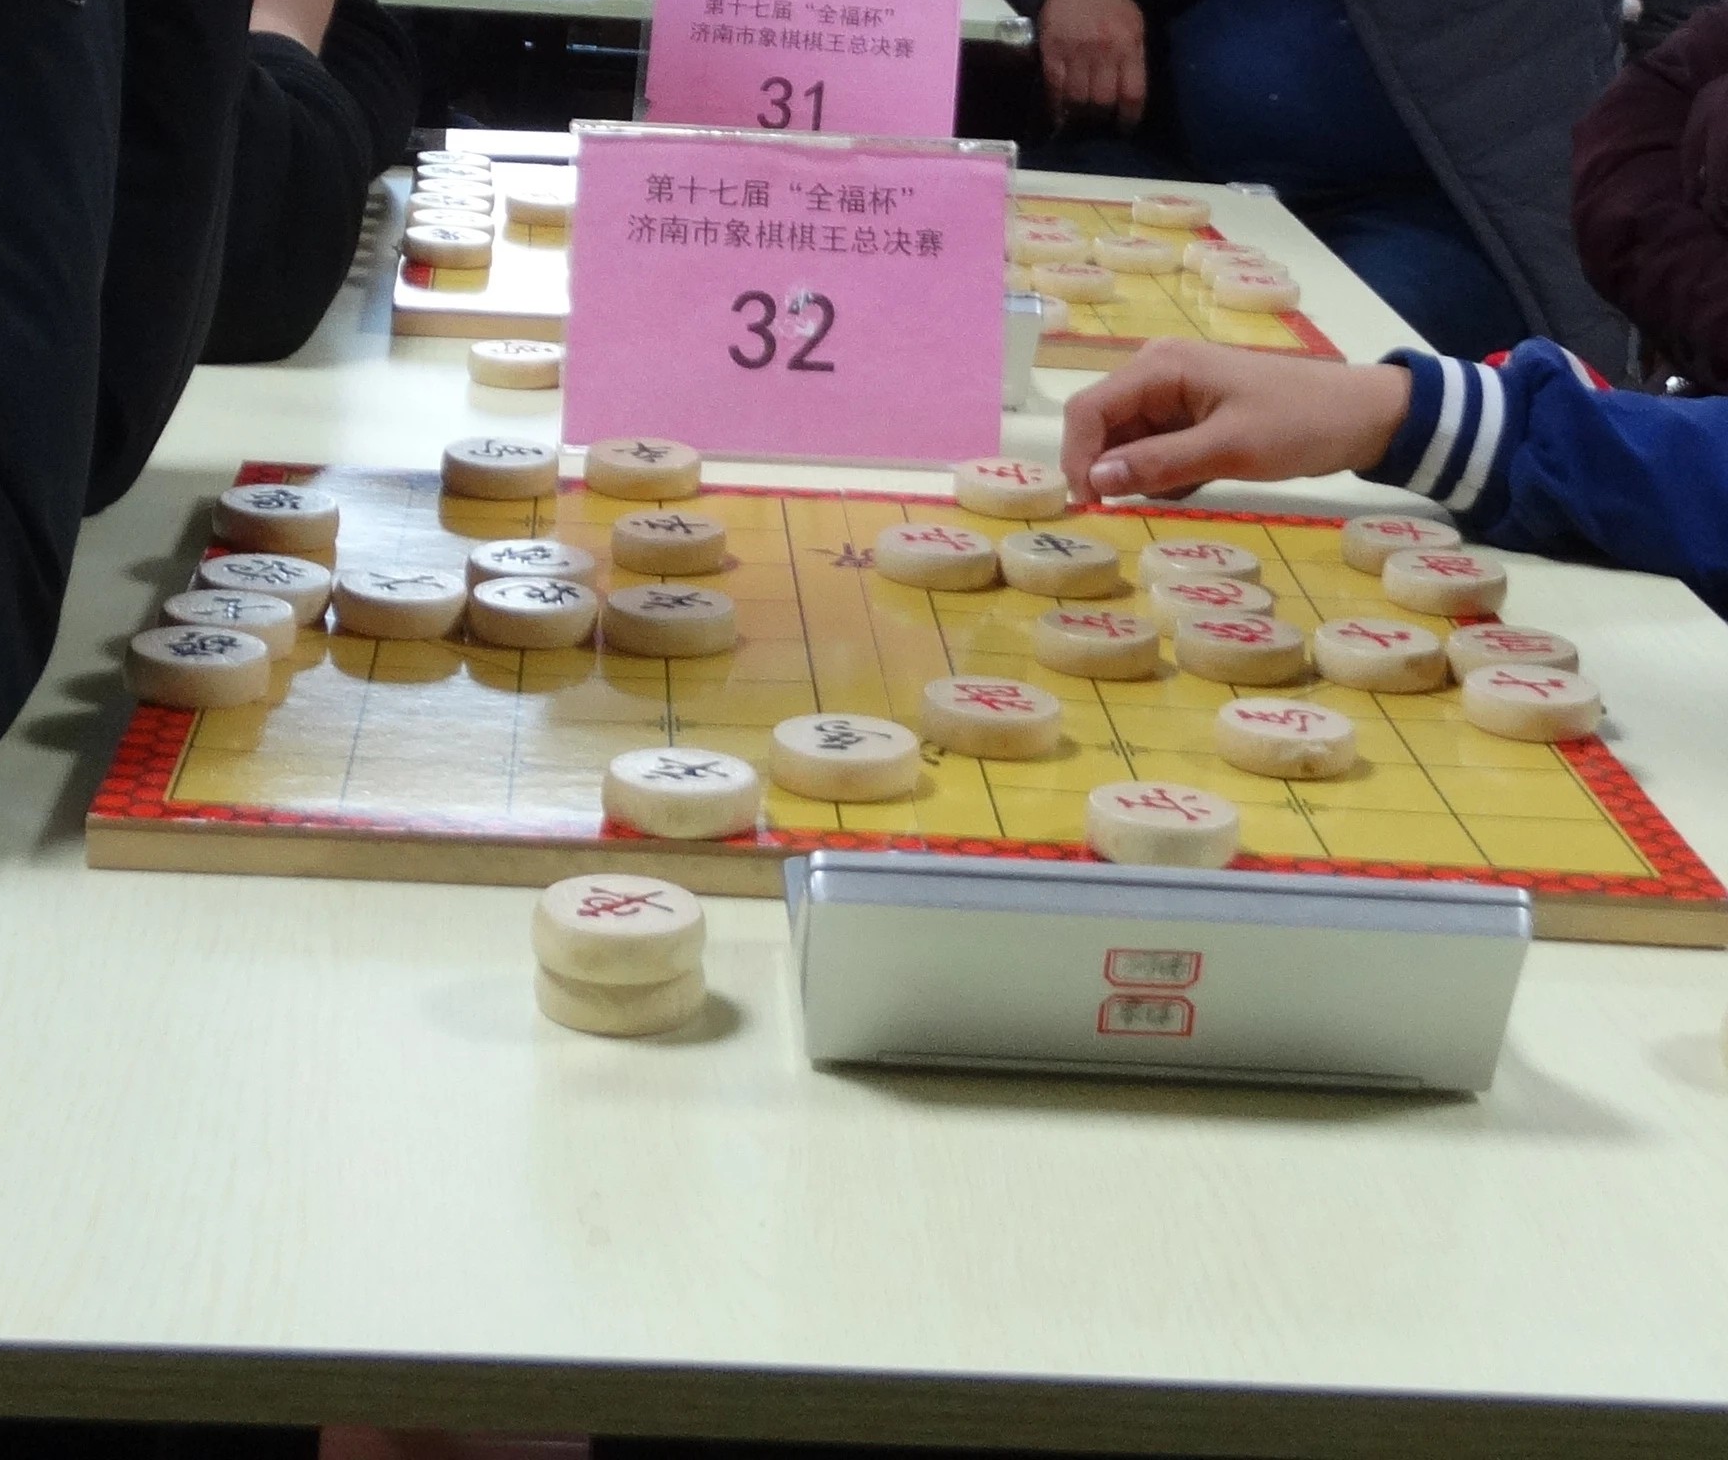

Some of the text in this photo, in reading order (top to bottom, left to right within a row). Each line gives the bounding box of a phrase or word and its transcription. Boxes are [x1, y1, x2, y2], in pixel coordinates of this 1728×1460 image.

[690, 21, 914, 58] 济南市象棋棋王总决赛
[756, 76, 825, 131] 31
[627, 213, 945, 259] 济南市象棋棋王总决赛
[727, 289, 837, 372] 32
